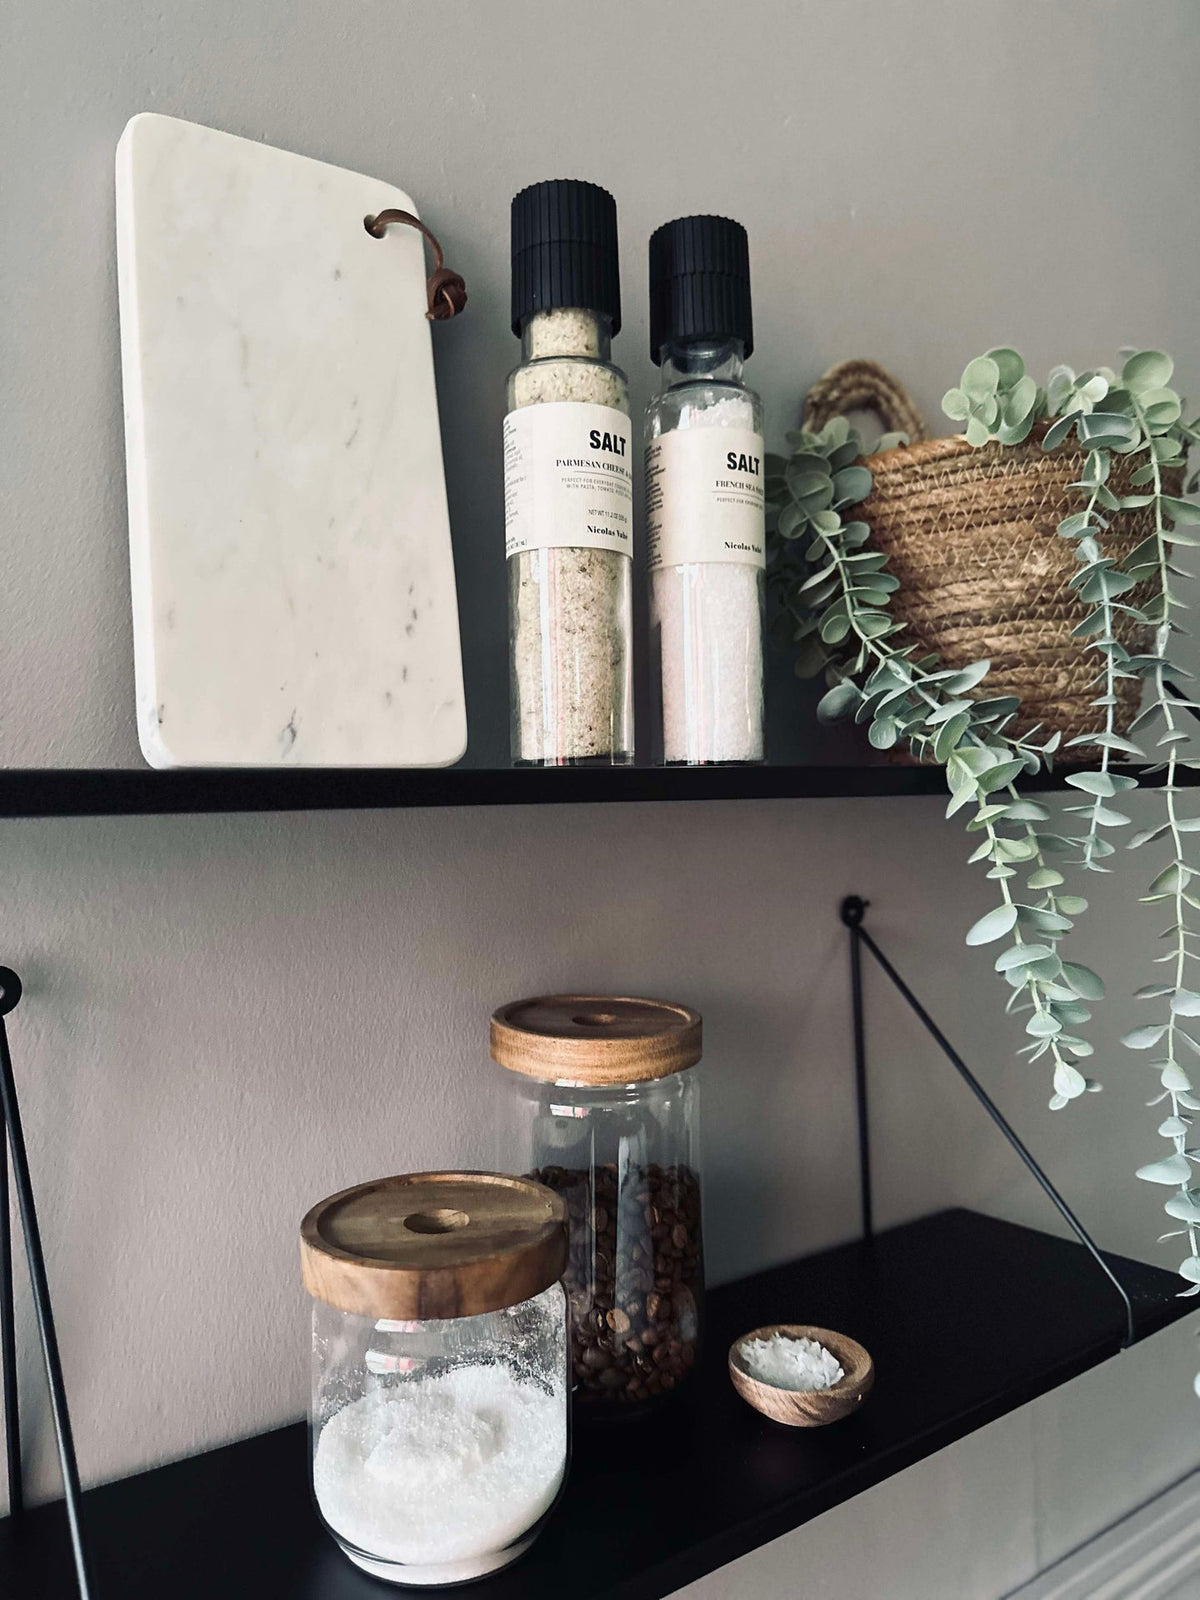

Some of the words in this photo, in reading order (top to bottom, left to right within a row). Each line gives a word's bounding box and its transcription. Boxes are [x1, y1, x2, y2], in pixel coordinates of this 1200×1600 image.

[589, 429, 626, 457] SALT
[556, 459, 601, 469] PARMESAN
[727, 451, 760, 475] SALT
[715, 480, 744, 489] FRENCH
[587, 525, 615, 537] Nicolas
[724, 541, 751, 551] Nicolas
